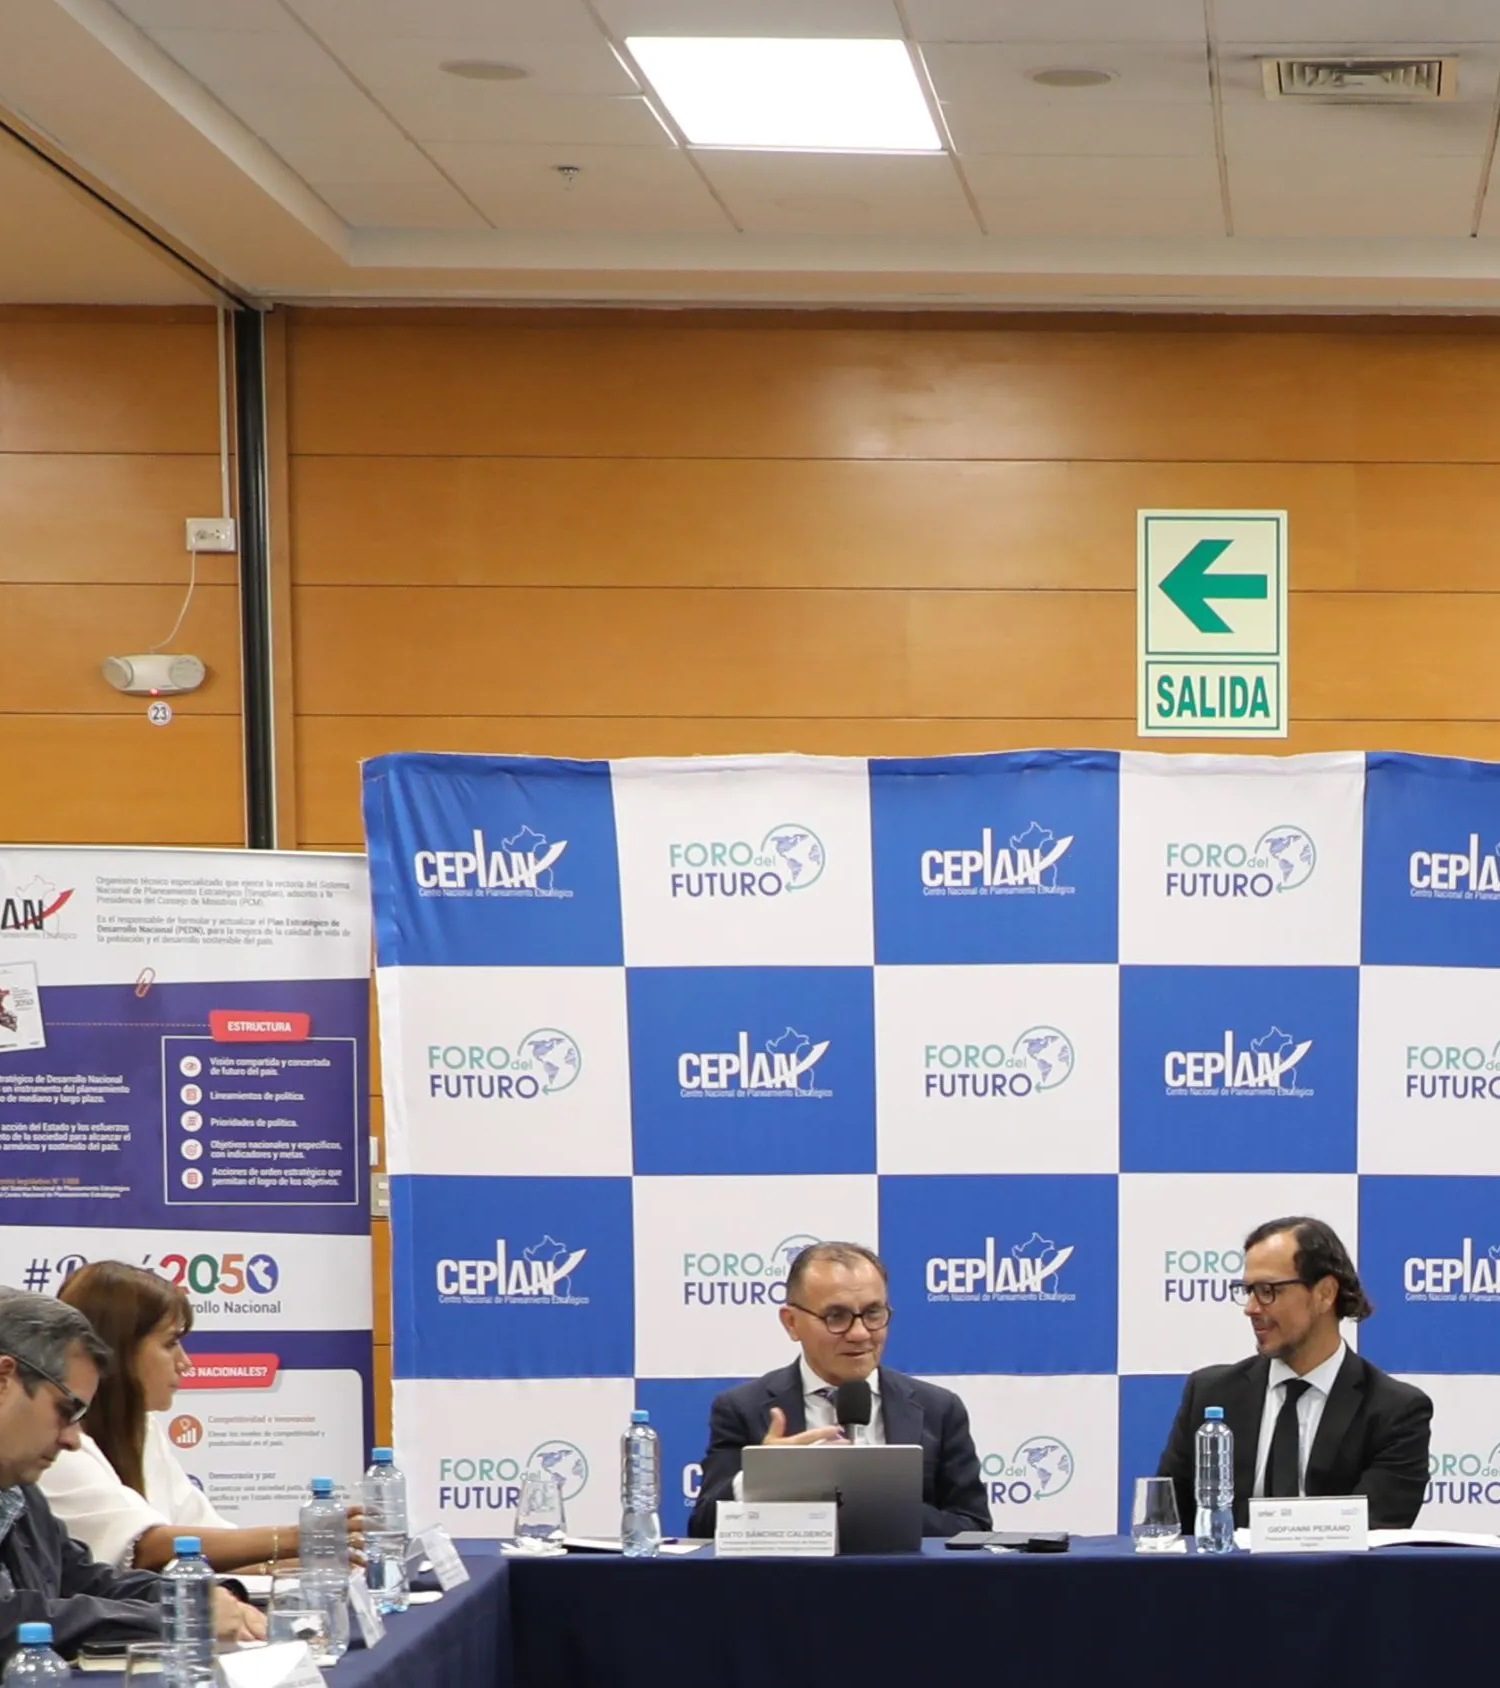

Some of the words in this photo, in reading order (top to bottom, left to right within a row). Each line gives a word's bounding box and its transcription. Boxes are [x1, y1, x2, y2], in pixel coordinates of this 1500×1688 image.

[1156, 675, 1270, 718] SALIDA
[152, 706, 167, 720] 23
[414, 829, 537, 889] CEPLAN
[669, 842, 753, 868] FORO
[754, 856, 776, 867] del
[920, 827, 1040, 887] CEPLAN
[1166, 842, 1247, 868] FORO
[1247, 857, 1269, 869] del
[671, 872, 782, 898] FUTURO
[923, 886, 946, 895] Centro
[947, 886, 978, 896] Nacional
[979, 887, 988, 895] de
[989, 887, 1036, 897] Planeamiento
[1165, 872, 1273, 898] FUTURO
[227, 1021, 292, 1032] ESTRUCTURA
[428, 1046, 510, 1070] FORO
[510, 1059, 533, 1071] del
[678, 1031, 797, 1089] CEPLAN
[924, 1044, 1005, 1069] FORO
[1005, 1056, 1027, 1069] del
[1165, 1030, 1279, 1087] CEPLAN
[1406, 1046, 1485, 1070] FORO
[430, 1074, 539, 1099] FUTURO
[924, 1073, 1032, 1098] FUTURO
[1165, 1087, 1188, 1096] Centro
[1188, 1087, 1219, 1097] Nacional
[1220, 1088, 1229, 1096] de
[1230, 1088, 1277, 1098] Planeamiento
[436, 1238, 554, 1295] CEPLAN
[683, 1253, 764, 1277] FORO
[764, 1264, 787, 1277] del
[926, 1236, 1042, 1293] CEPLAN
[438, 1294, 461, 1303] Centro
[462, 1294, 492, 1304] Nacional
[493, 1295, 503, 1303] de
[504, 1295, 550, 1305] Planeamiento
[927, 1293, 950, 1302] Centro
[951, 1293, 981, 1302] Nacional
[982, 1293, 991, 1302] de
[992, 1293, 1038, 1303] Planeamiento
[1165, 1279, 1236, 1303] FUTU
[224, 1301, 282, 1314] Nacional
[198, 1366, 268, 1377] NACIONALES?
[439, 1458, 519, 1482] FORO
[1004, 1464, 1027, 1477] del
[1428, 1453, 1481, 1477] ORO
